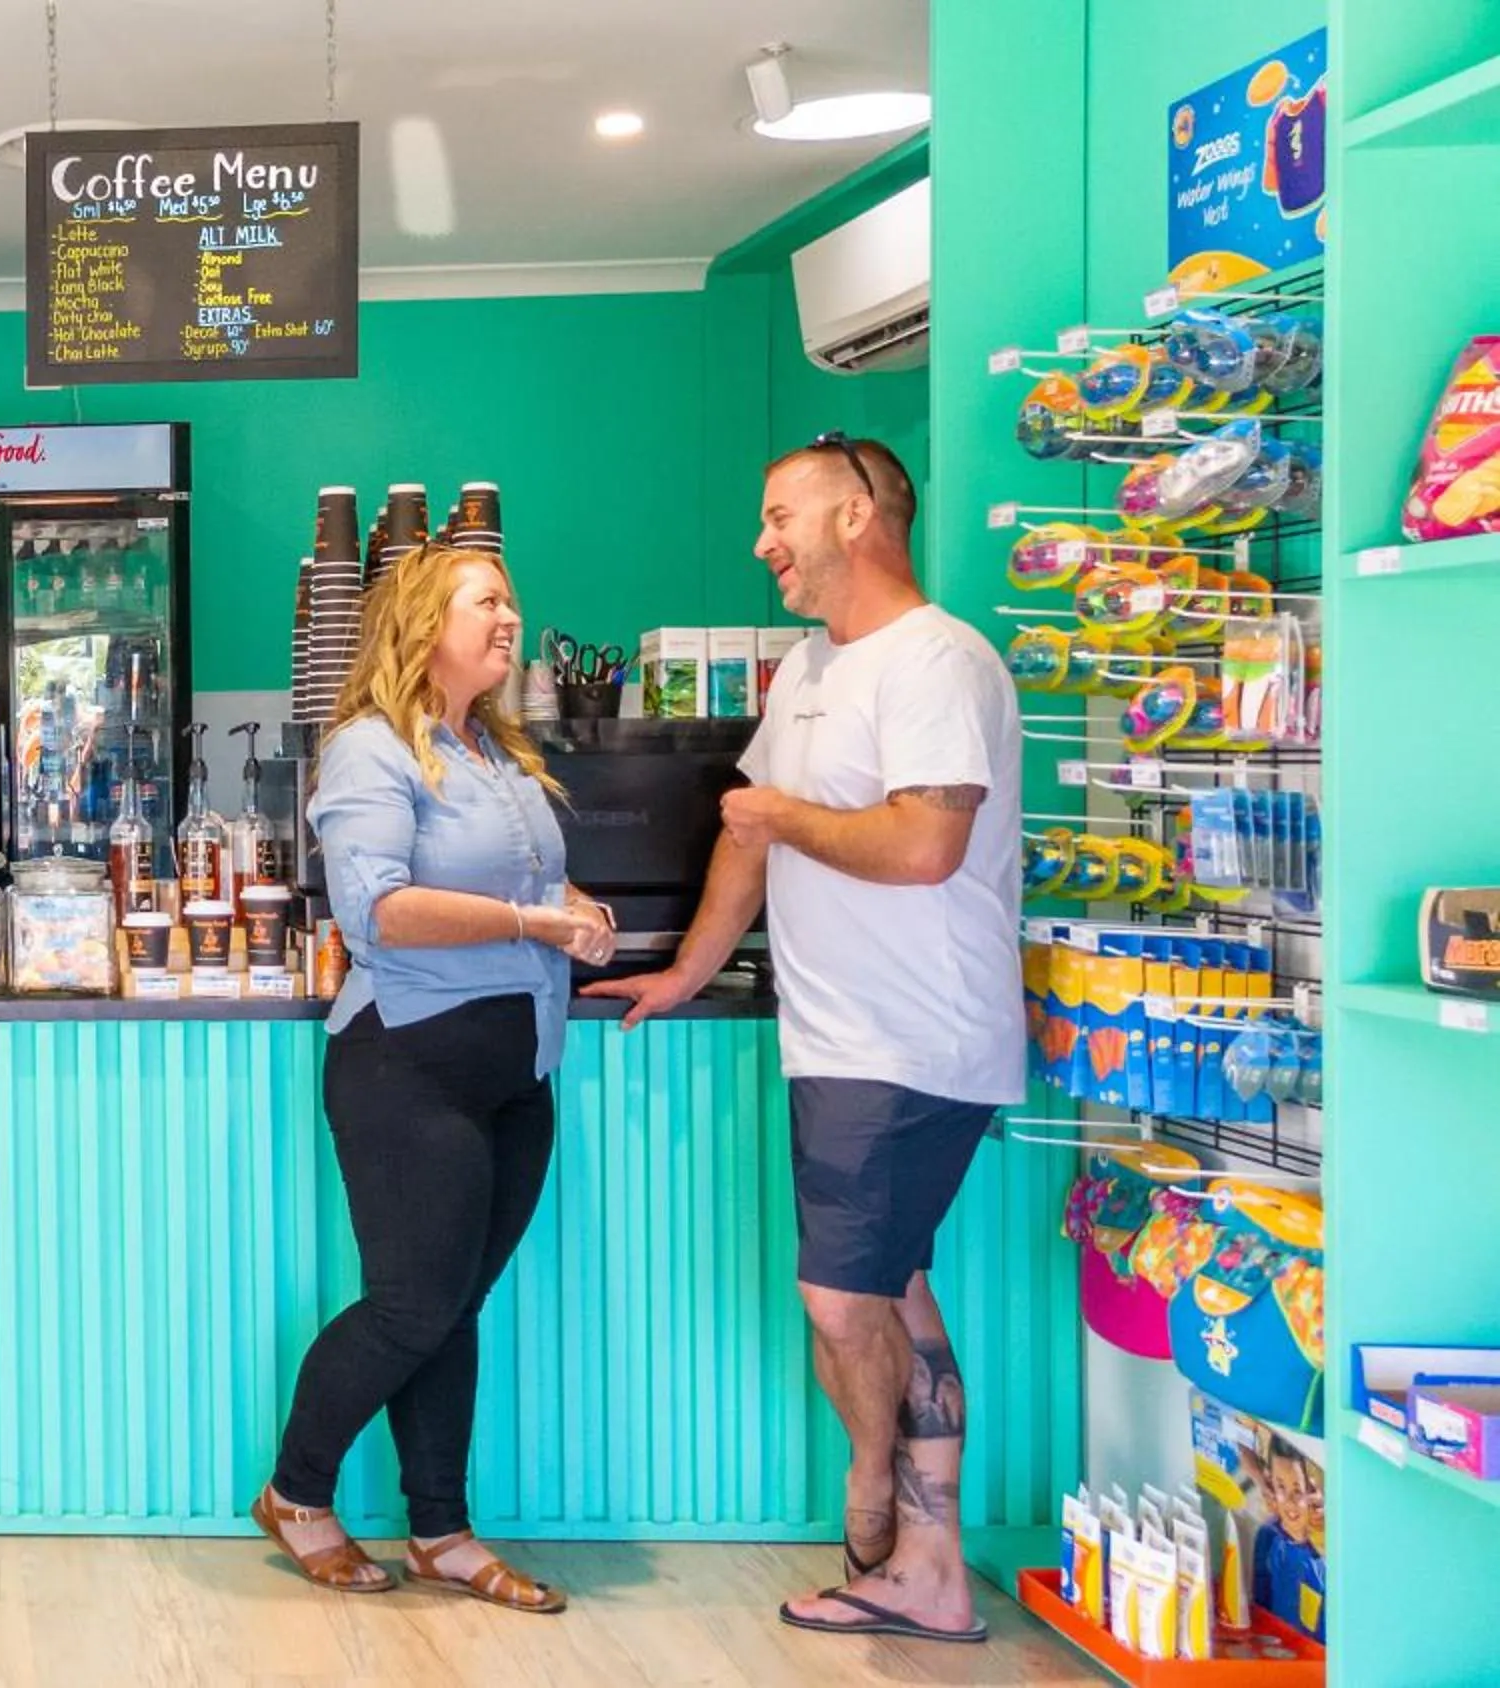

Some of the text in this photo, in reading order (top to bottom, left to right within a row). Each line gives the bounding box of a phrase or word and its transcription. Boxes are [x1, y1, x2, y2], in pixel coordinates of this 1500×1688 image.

[51, 151, 318, 201] Coffee Menu
[159, 198, 189, 217] Med
[243, 192, 267, 220] Lge
[199, 225, 278, 246] ALT MILK
[198, 306, 252, 324] EXTRAS
